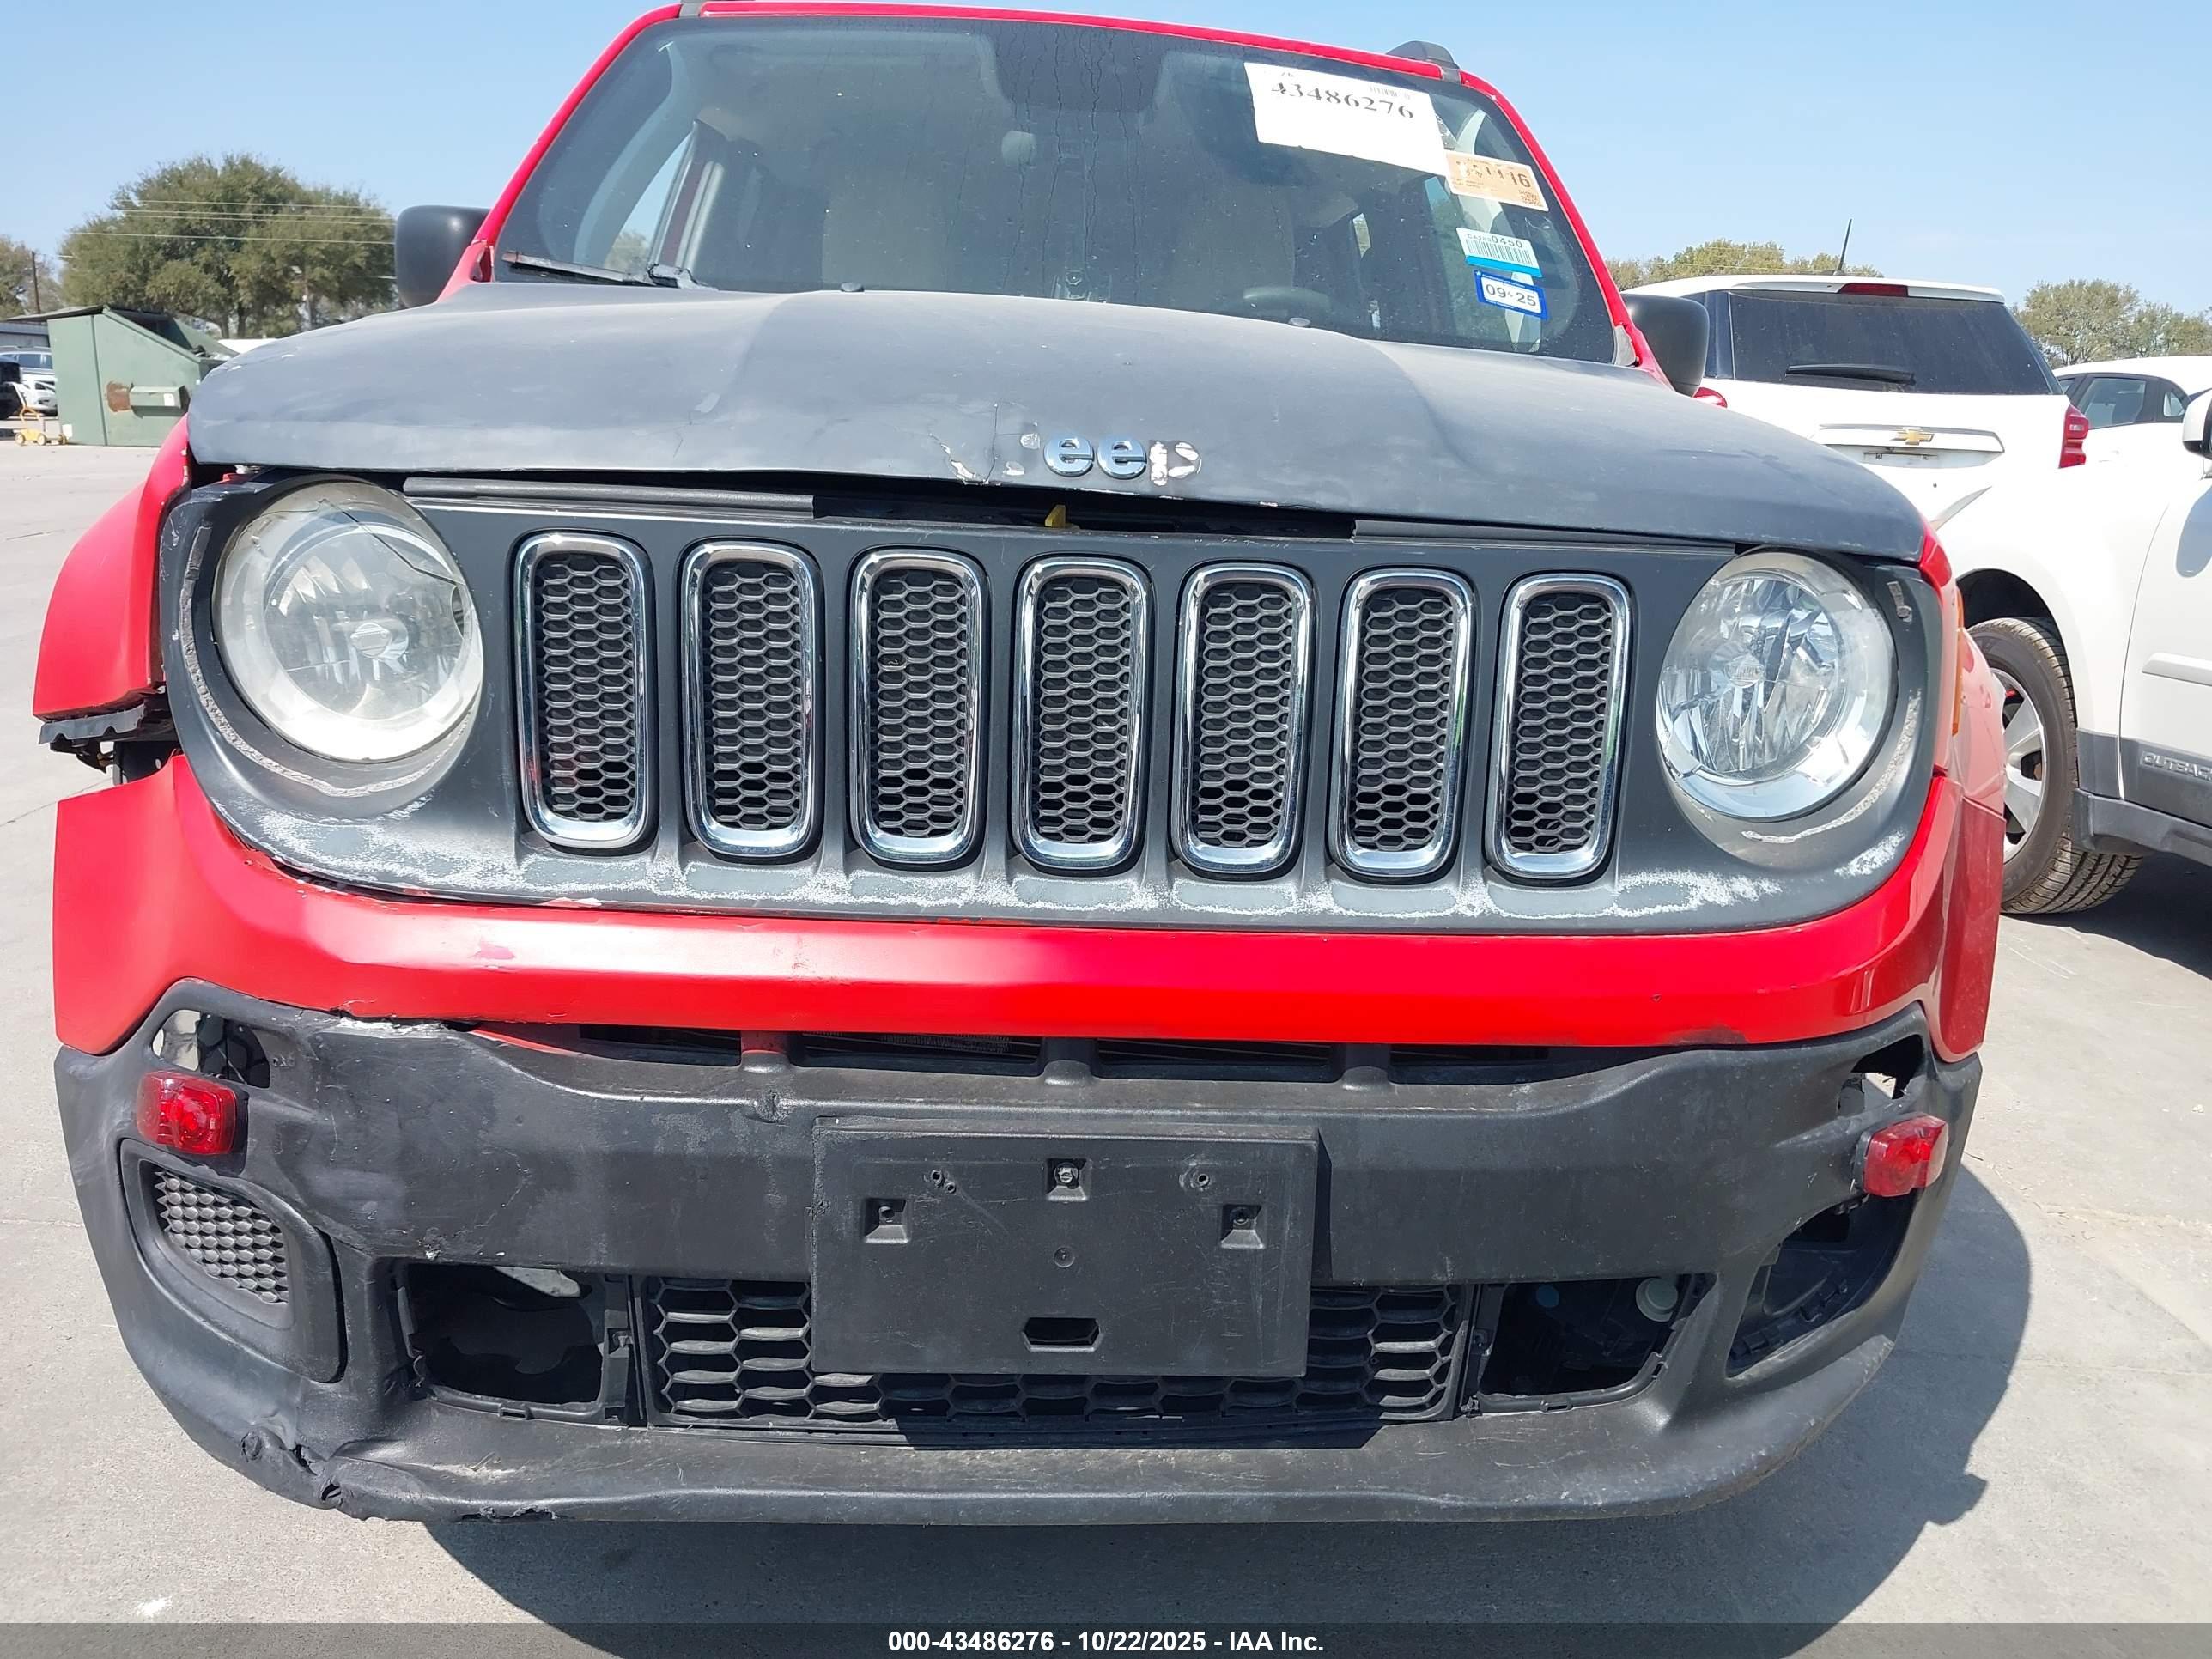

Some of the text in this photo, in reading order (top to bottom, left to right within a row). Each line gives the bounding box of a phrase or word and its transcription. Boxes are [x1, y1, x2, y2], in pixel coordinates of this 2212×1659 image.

[1271, 82, 1414, 118] 43486276
[1486, 283, 1537, 307] 09 25
[1003, 431, 1203, 487] eep
[2143, 751, 2212, 781] OUTBAC
